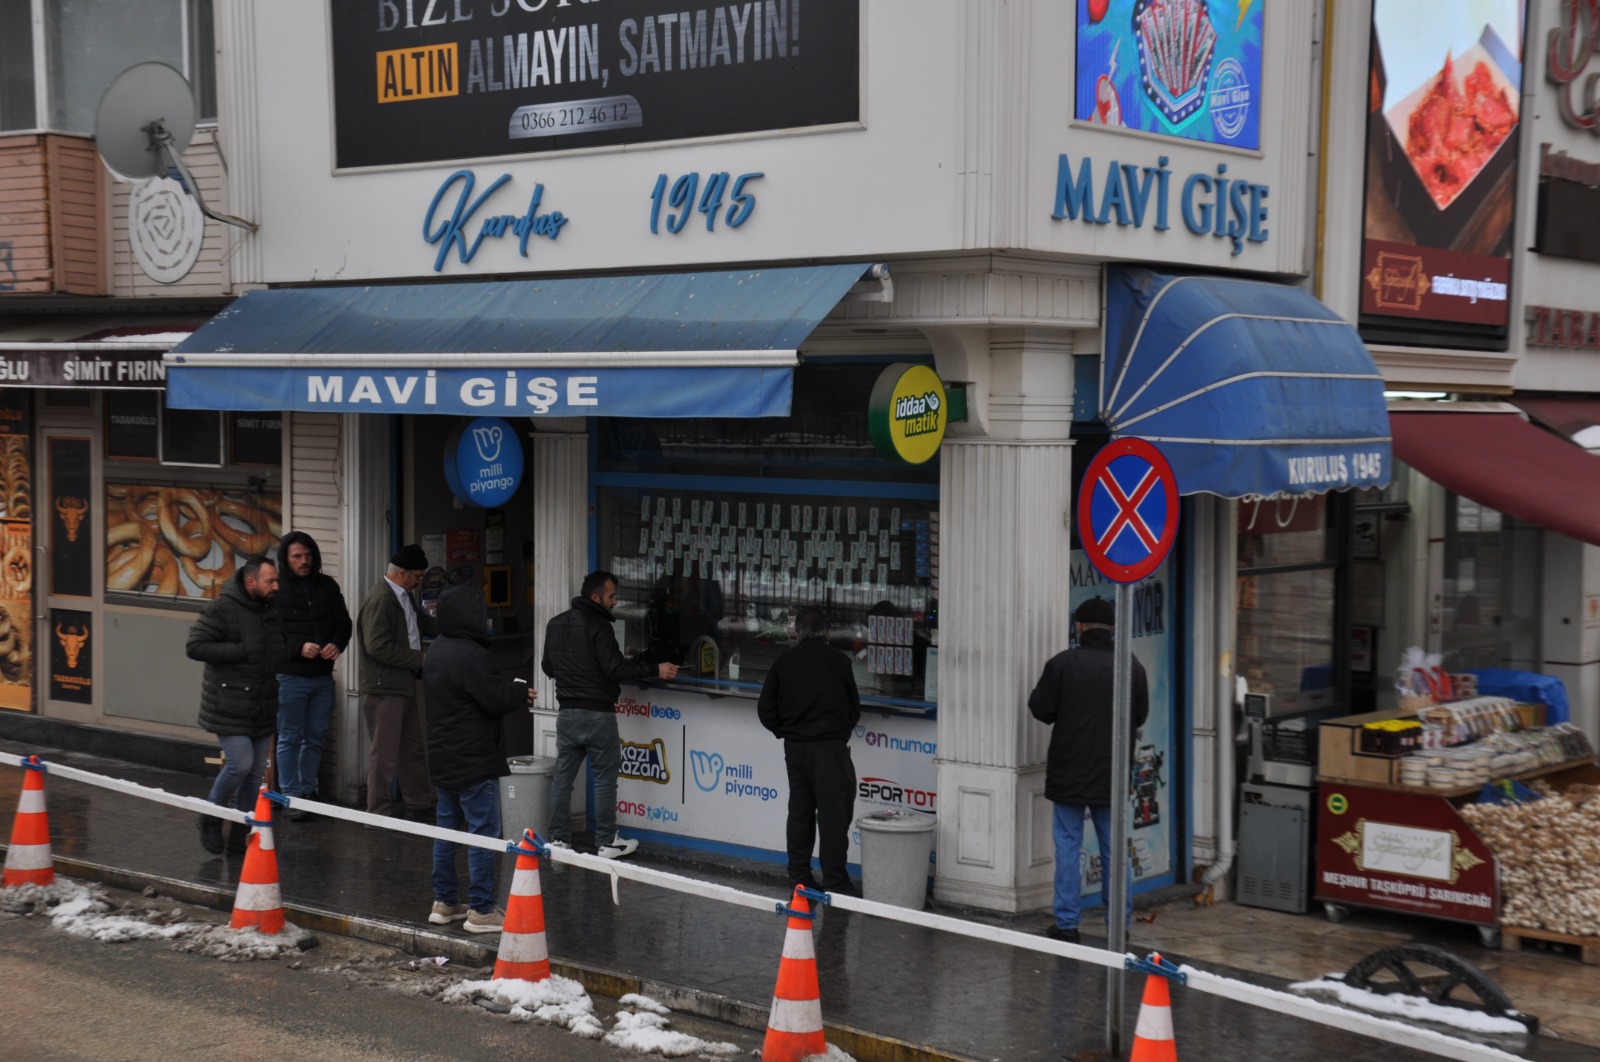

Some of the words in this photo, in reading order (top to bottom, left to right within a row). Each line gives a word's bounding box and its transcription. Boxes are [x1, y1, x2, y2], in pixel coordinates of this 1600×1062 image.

[383, 48, 453, 98] ALTIN
[467, 24, 609, 94] ALMAYIN,
[619, 0, 799, 77] SATMAYIN!
[521, 111, 555, 131] 0366
[559, 107, 585, 127] 212
[589, 105, 607, 124] 46
[611, 102, 629, 122] 12
[650, 172, 765, 234] 1945
[1051, 153, 1173, 231] MAVİ
[1181, 163, 1270, 257] GİŞE
[63, 356, 112, 381] SİMİT
[308, 370, 437, 405] MAVİ
[460, 371, 599, 414] GİŞE
[111, 414, 156, 425] TABAKOĞLU
[896, 396, 926, 419] iddaa
[238, 416, 260, 428] SİMİT
[905, 411, 938, 436] matik
[479, 464, 503, 478] milli
[1288, 454, 1349, 486] KURULUŞ
[1353, 453, 1382, 479] 1945
[470, 476, 514, 494] piyango
[652, 705, 681, 720] loto
[865, 731, 889, 749] on
[725, 764, 753, 780] milli
[725, 780, 778, 801] piyango
[1323, 871, 1369, 889] MEŞHUR
[1369, 878, 1427, 899] TAŞKÖPRÜ
[1428, 887, 1492, 909] SARIMSAĞI
